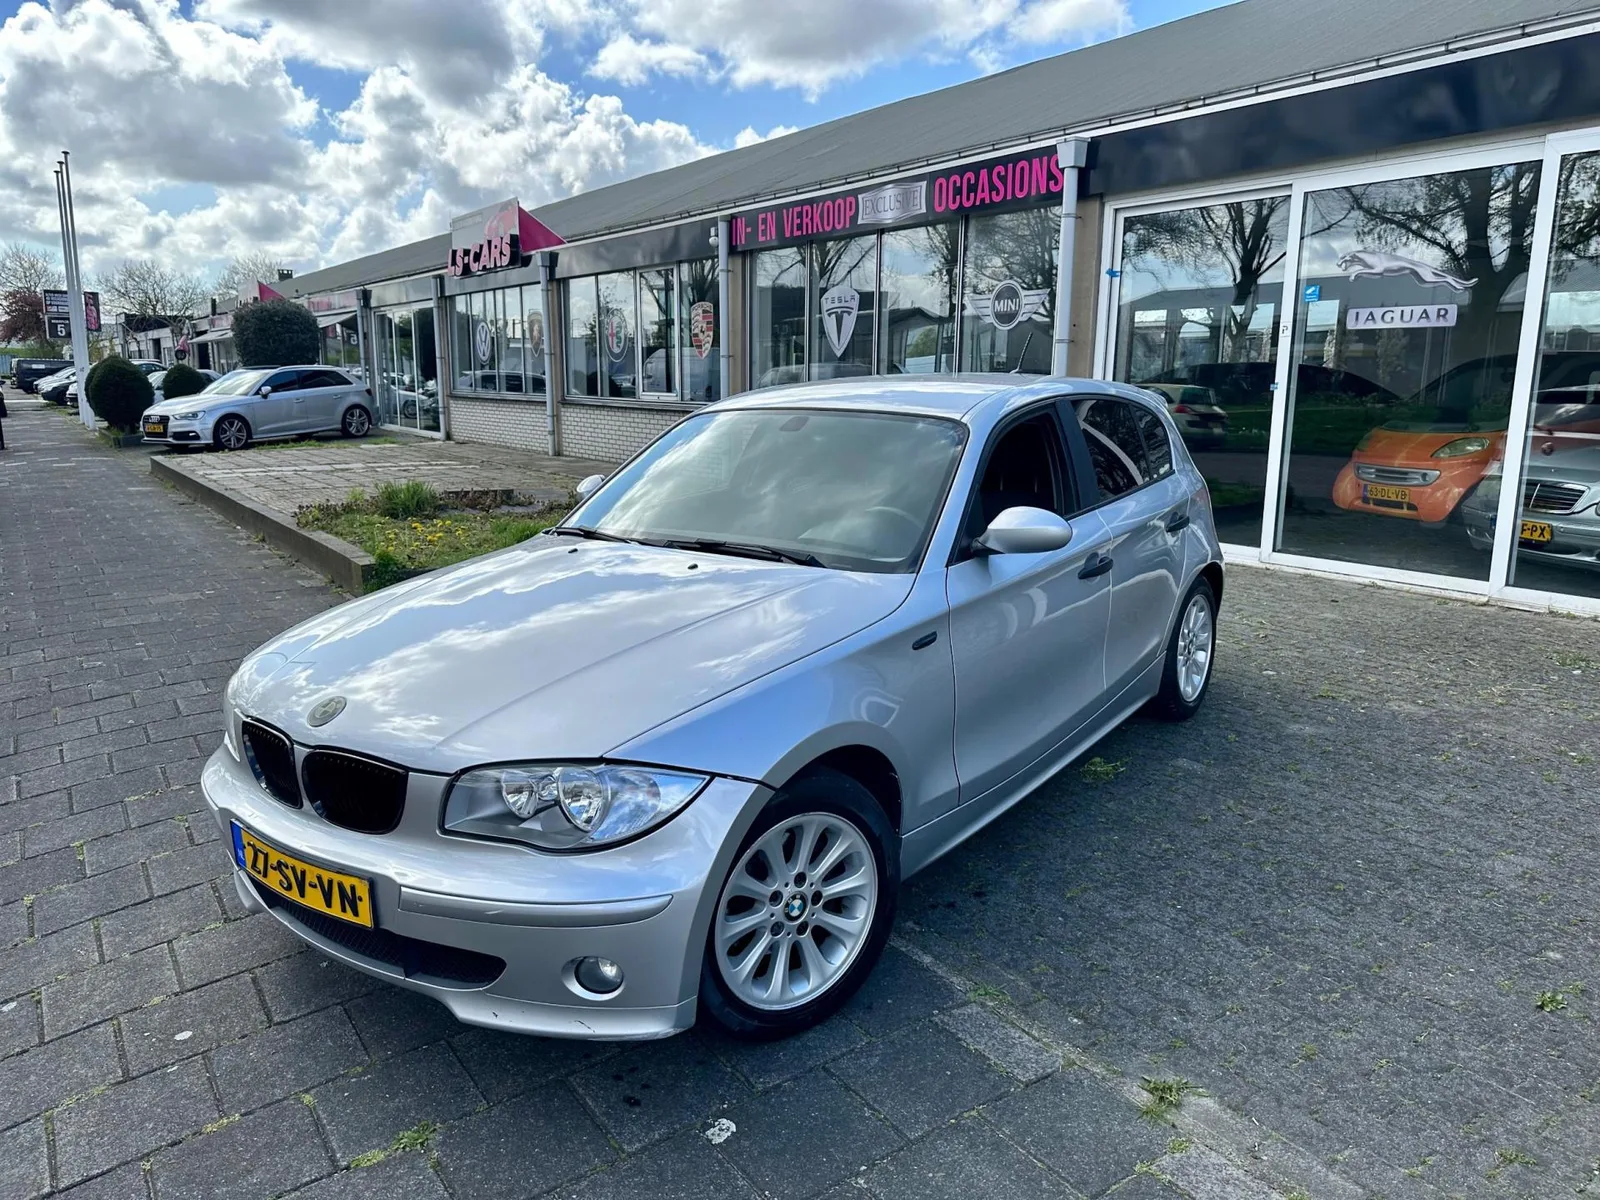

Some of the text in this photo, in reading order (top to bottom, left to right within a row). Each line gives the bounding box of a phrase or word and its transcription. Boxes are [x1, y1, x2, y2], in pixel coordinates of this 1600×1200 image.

[732, 154, 1064, 246] IN- EN VERKOOP EXCLUSIVE OCCASIONS
[447, 233, 511, 276] LS-CARS
[824, 295, 856, 305] TESLA
[994, 298, 1020, 313] MINI
[1353, 307, 1449, 327] JAGUAR
[57, 324, 66, 337] 5
[247, 841, 360, 917] 27-SV-VN
